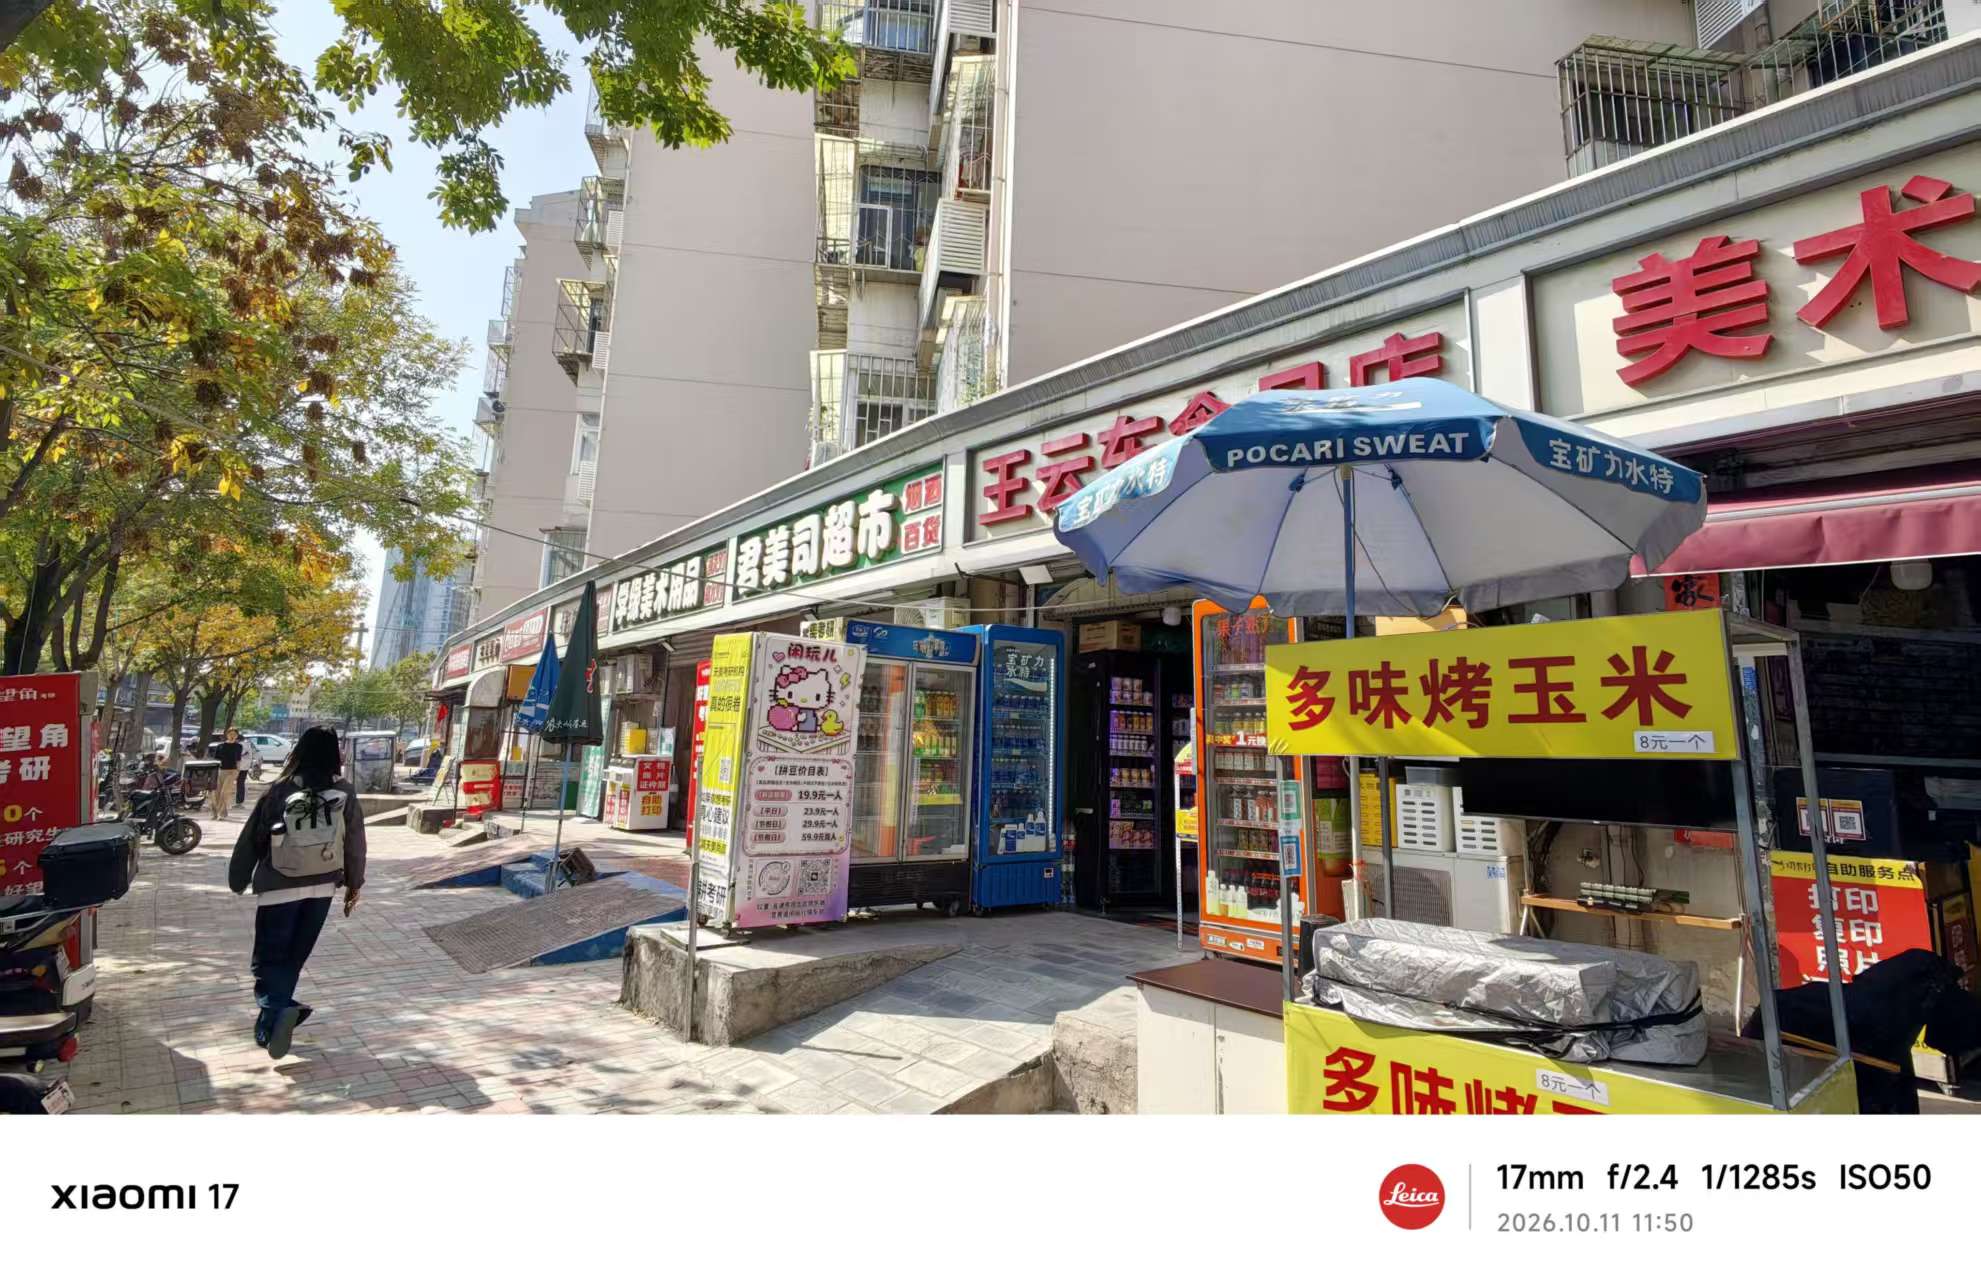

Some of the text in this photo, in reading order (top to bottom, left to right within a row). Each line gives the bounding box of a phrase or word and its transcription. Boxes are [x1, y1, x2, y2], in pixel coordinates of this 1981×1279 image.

[1611, 175, 1981, 387] 美术
[1227, 431, 1470, 468] POCARI SWEAT
[1548, 438, 1674, 495] 宝矿力水特
[736, 488, 895, 599] 君美司超市
[903, 514, 941, 552] 百货
[787, 642, 837, 663] 闲玩儿
[1285, 644, 1693, 731] 多味烤玉米
[1639, 732, 1707, 752] 8元一个
[1807, 883, 1879, 915] 打印
[1811, 913, 1884, 947] 复印
[1322, 1046, 1609, 1114] 多味
[1540, 1075, 1600, 1100] 8元一个
